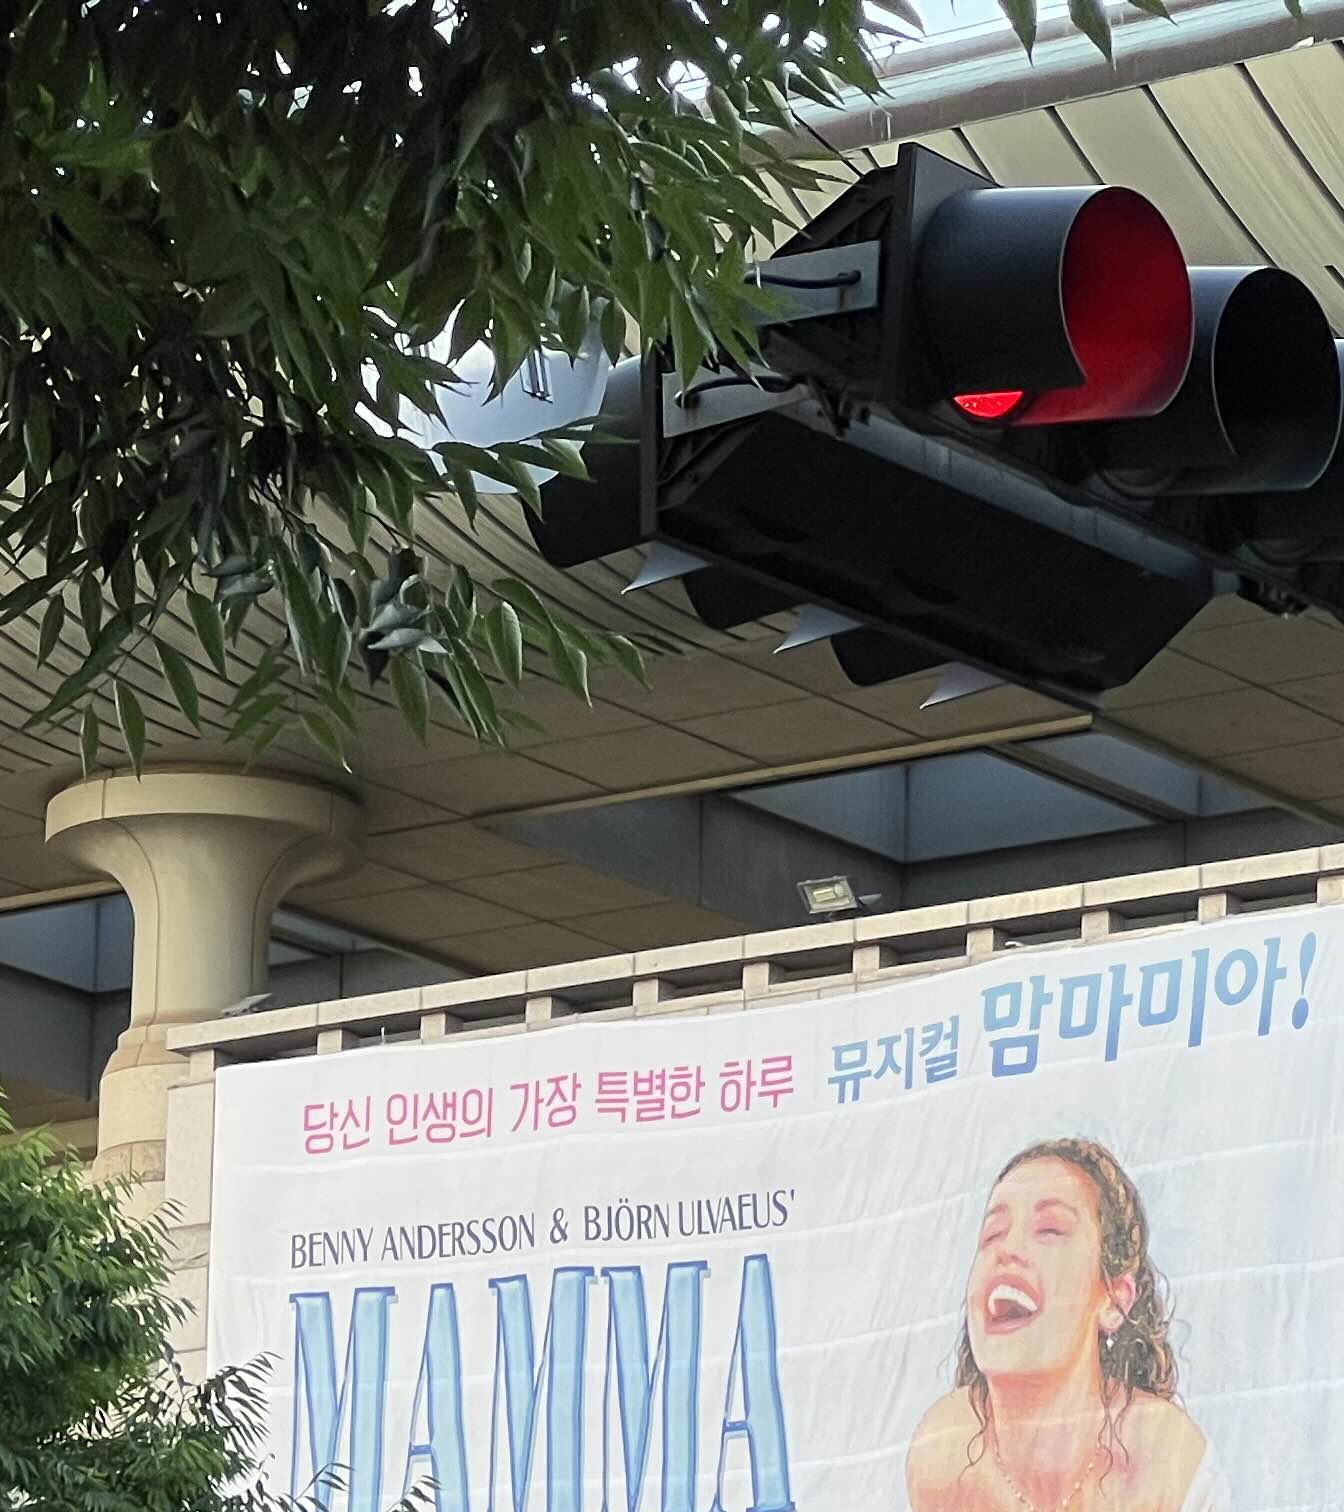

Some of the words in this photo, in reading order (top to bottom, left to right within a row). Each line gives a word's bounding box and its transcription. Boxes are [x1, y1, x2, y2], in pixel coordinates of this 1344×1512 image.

[827, 1015, 960, 1104] 뮤지컬
[981, 932, 1317, 1078] 맘마미아!
[304, 1096, 370, 1154] 당신
[386, 1087, 494, 1146] 인생의
[510, 1072, 582, 1132] 가장
[595, 1065, 706, 1123] 특별한
[719, 1055, 795, 1112] 하루
[290, 1227, 374, 1269] BENNY
[381, 1212, 535, 1262] ANDERSSON
[548, 1206, 569, 1244] &
[583, 1197, 670, 1242] BJÖRN
